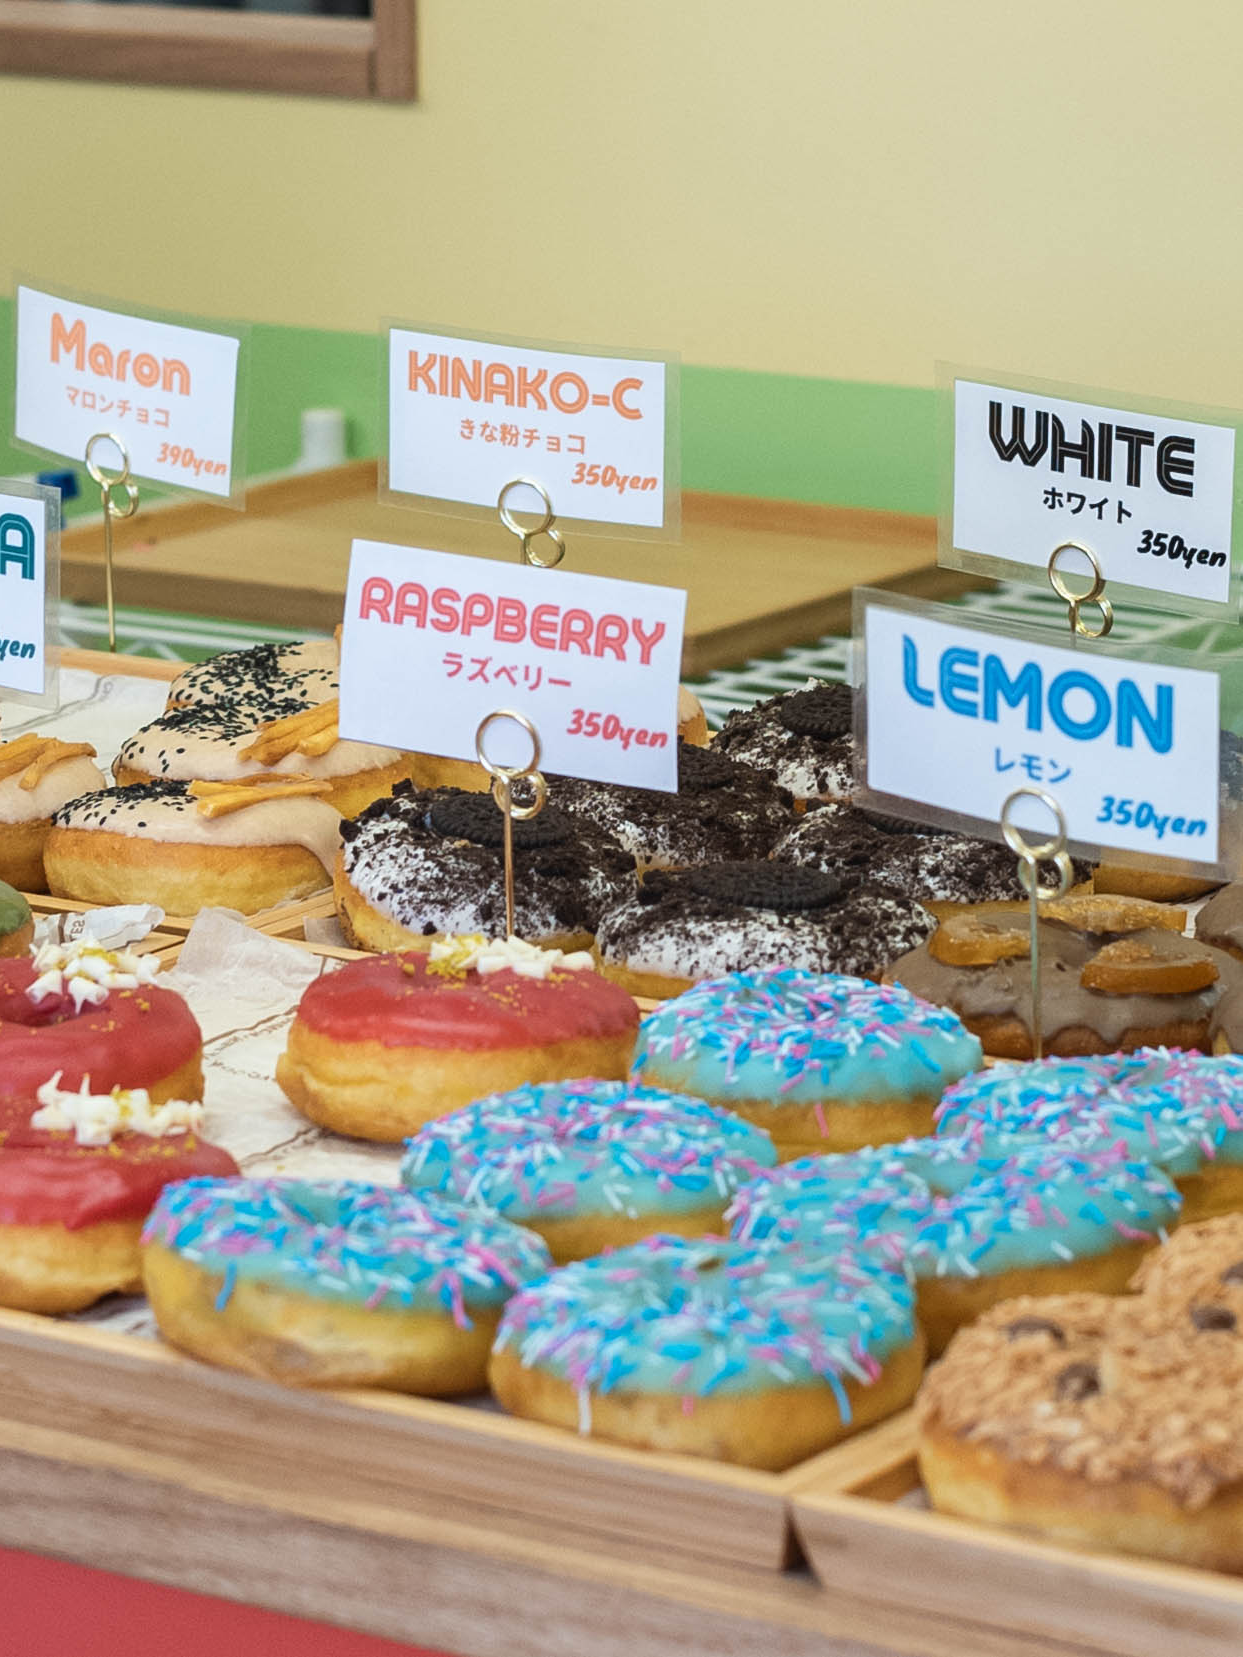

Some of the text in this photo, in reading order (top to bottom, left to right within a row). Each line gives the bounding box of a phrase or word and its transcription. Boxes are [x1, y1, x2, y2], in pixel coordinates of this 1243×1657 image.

[50, 312, 191, 396] Maron
[408, 350, 644, 420] KINAKO-C
[66, 385, 170, 427] マロンチョコ
[460, 418, 585, 454] きな粉チョコ
[988, 400, 1195, 497] WHITE
[157, 442, 227, 476] 390yen
[572, 462, 658, 494] 350yen
[1043, 487, 1132, 524] ホワイト
[1137, 529, 1227, 569] 350yen
[359, 576, 666, 665] RASPBERRY
[442, 651, 571, 691] ラズベリー
[902, 633, 1174, 754] LEMON
[567, 709, 668, 750] 350yen
[995, 746, 1072, 784] レモン
[1097, 796, 1207, 839] 350yen
